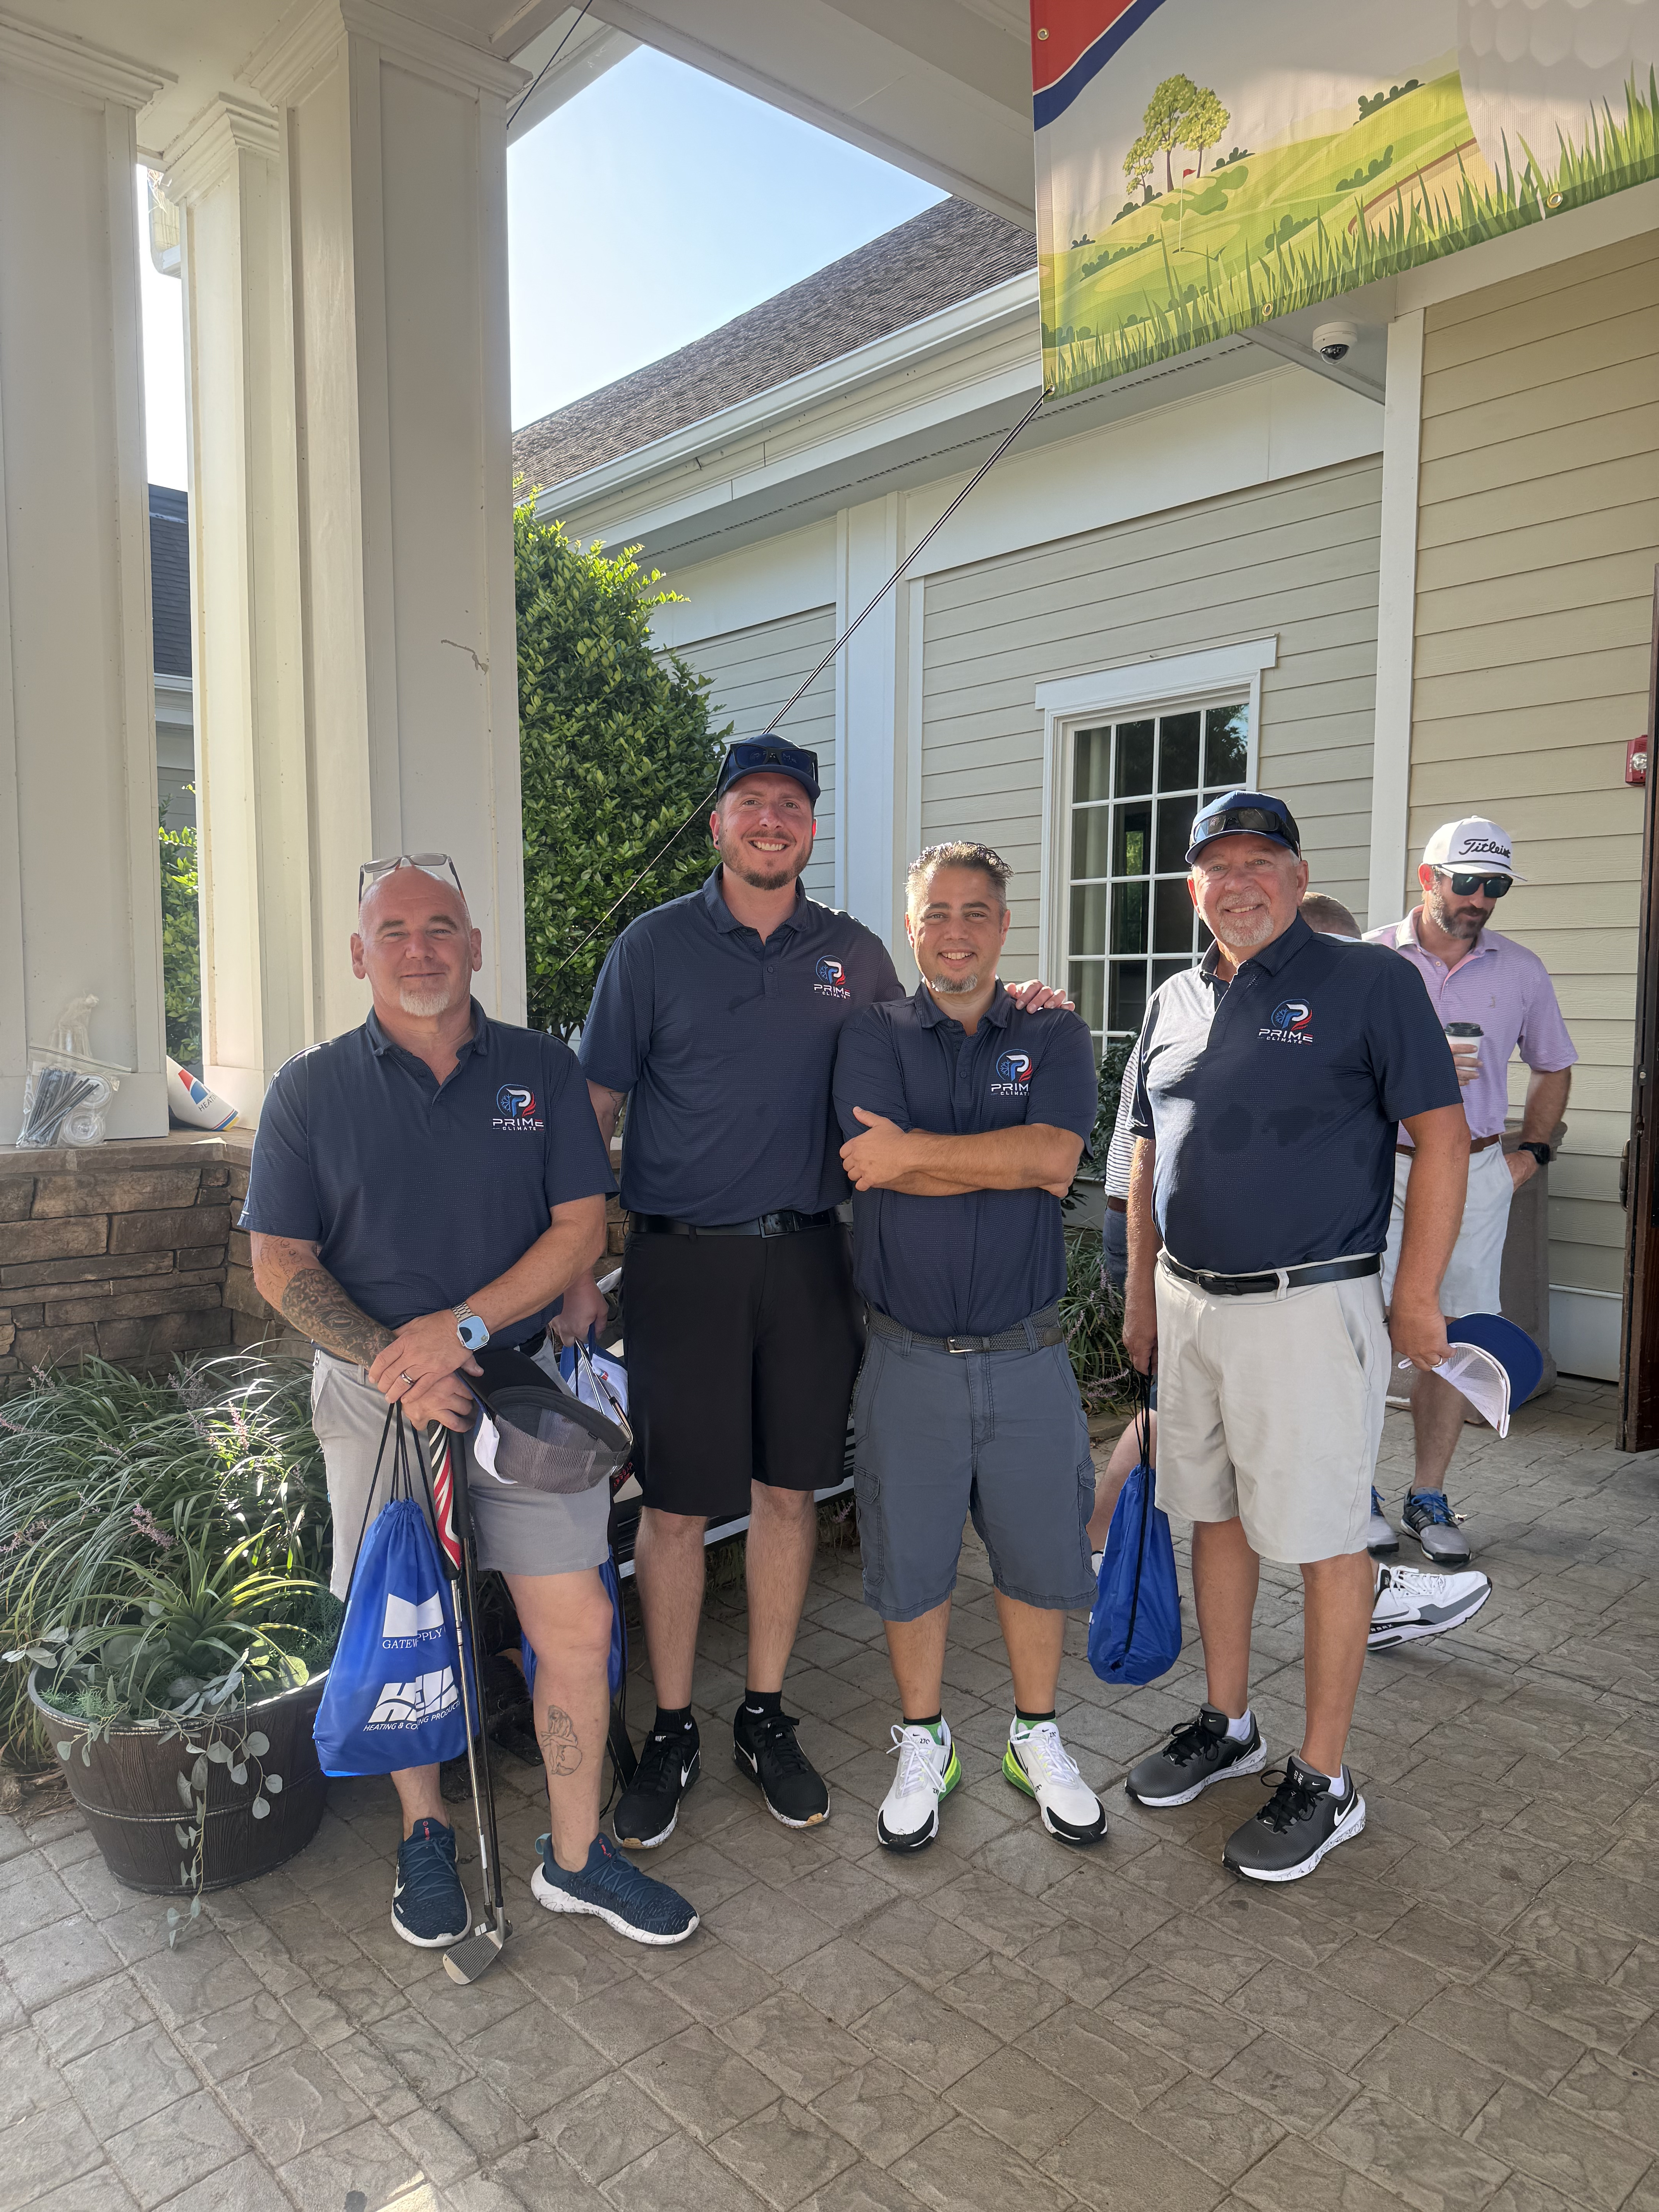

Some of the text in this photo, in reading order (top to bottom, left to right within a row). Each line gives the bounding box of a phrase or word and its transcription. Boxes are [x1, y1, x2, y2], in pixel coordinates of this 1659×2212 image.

[814, 984, 850, 997] PRIME
[1259, 1029, 1313, 1042] PRIME
[991, 1083, 1029, 1092] PRIM
[492, 1118, 544, 1127] PRIME
[363, 1723, 397, 1731] HEATING
